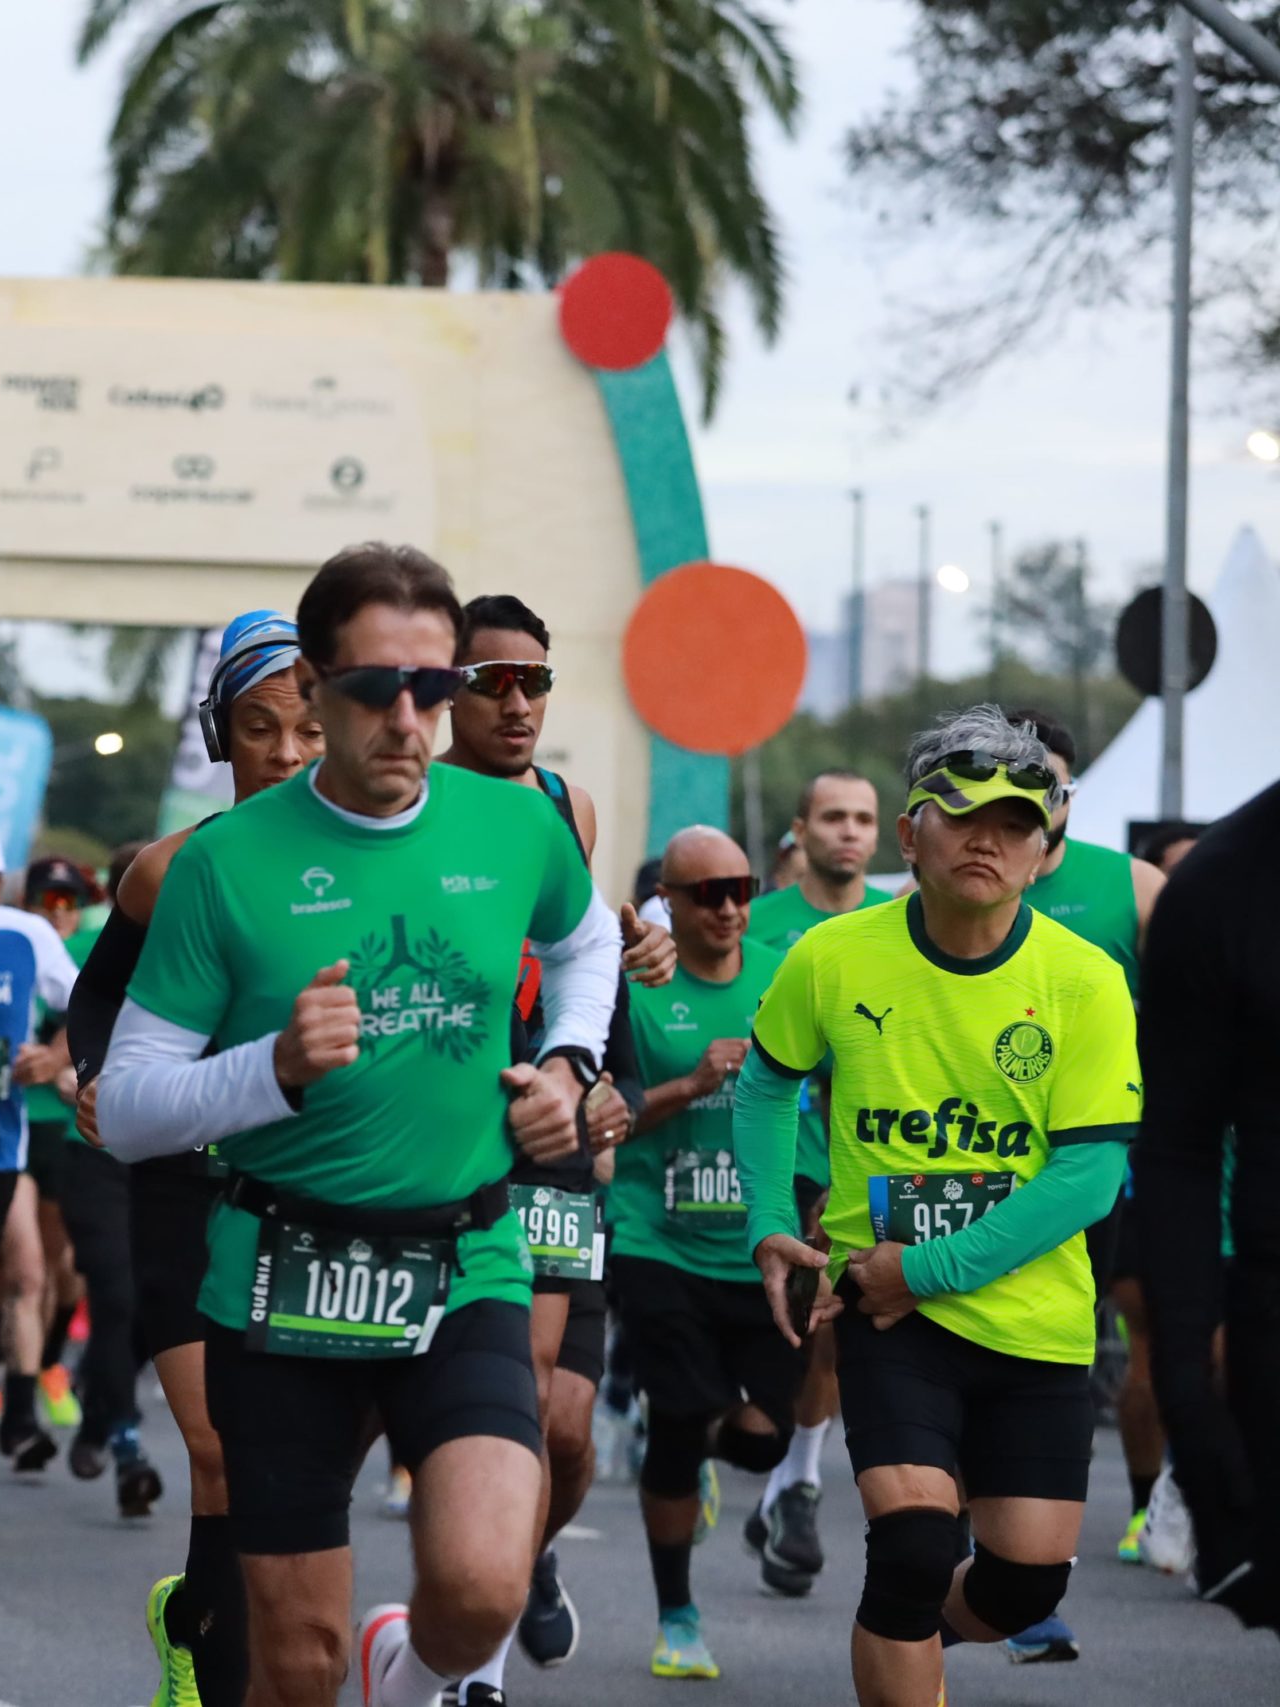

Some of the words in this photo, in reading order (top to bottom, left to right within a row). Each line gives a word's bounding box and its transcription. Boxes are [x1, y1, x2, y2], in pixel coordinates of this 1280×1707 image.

[290, 898, 352, 915] bradesco
[371, 986, 401, 1009] WE
[410, 982, 445, 1004] ALL
[359, 1003, 476, 1036] REATHE
[997, 1044, 1051, 1080] PALMEIRAS
[856, 1097, 1033, 1158] crefisa
[692, 1167, 741, 1203] 1005
[251, 1255, 272, 1322] QUÊNIA
[306, 1259, 414, 1325] 10012
